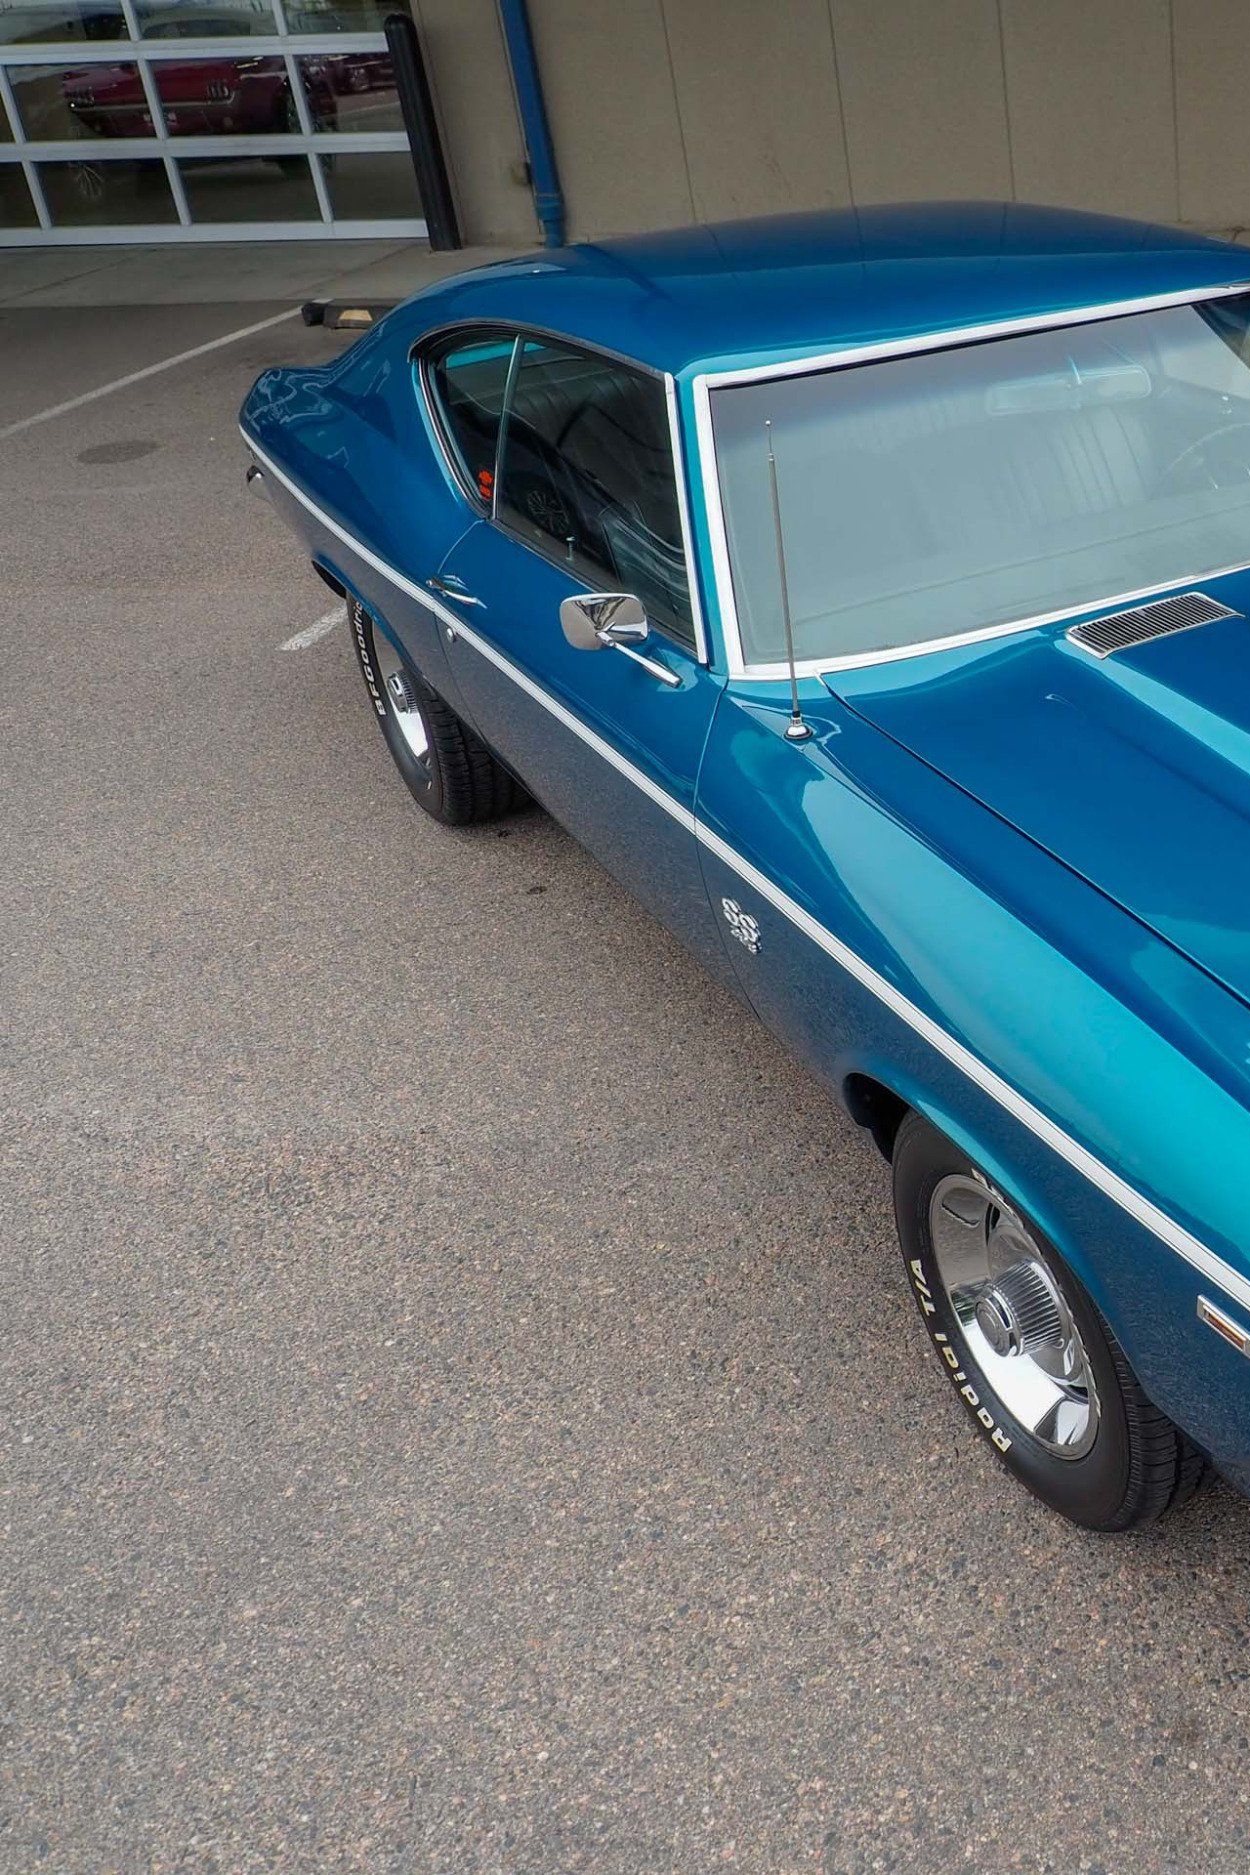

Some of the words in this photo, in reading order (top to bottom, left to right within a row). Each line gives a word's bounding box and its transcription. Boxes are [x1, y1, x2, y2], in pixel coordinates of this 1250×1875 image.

[353, 601, 386, 716] BFGoodric
[722, 898, 760, 944] SS
[910, 1259, 935, 1316] T/A
[935, 1333, 1012, 1452] Radial
